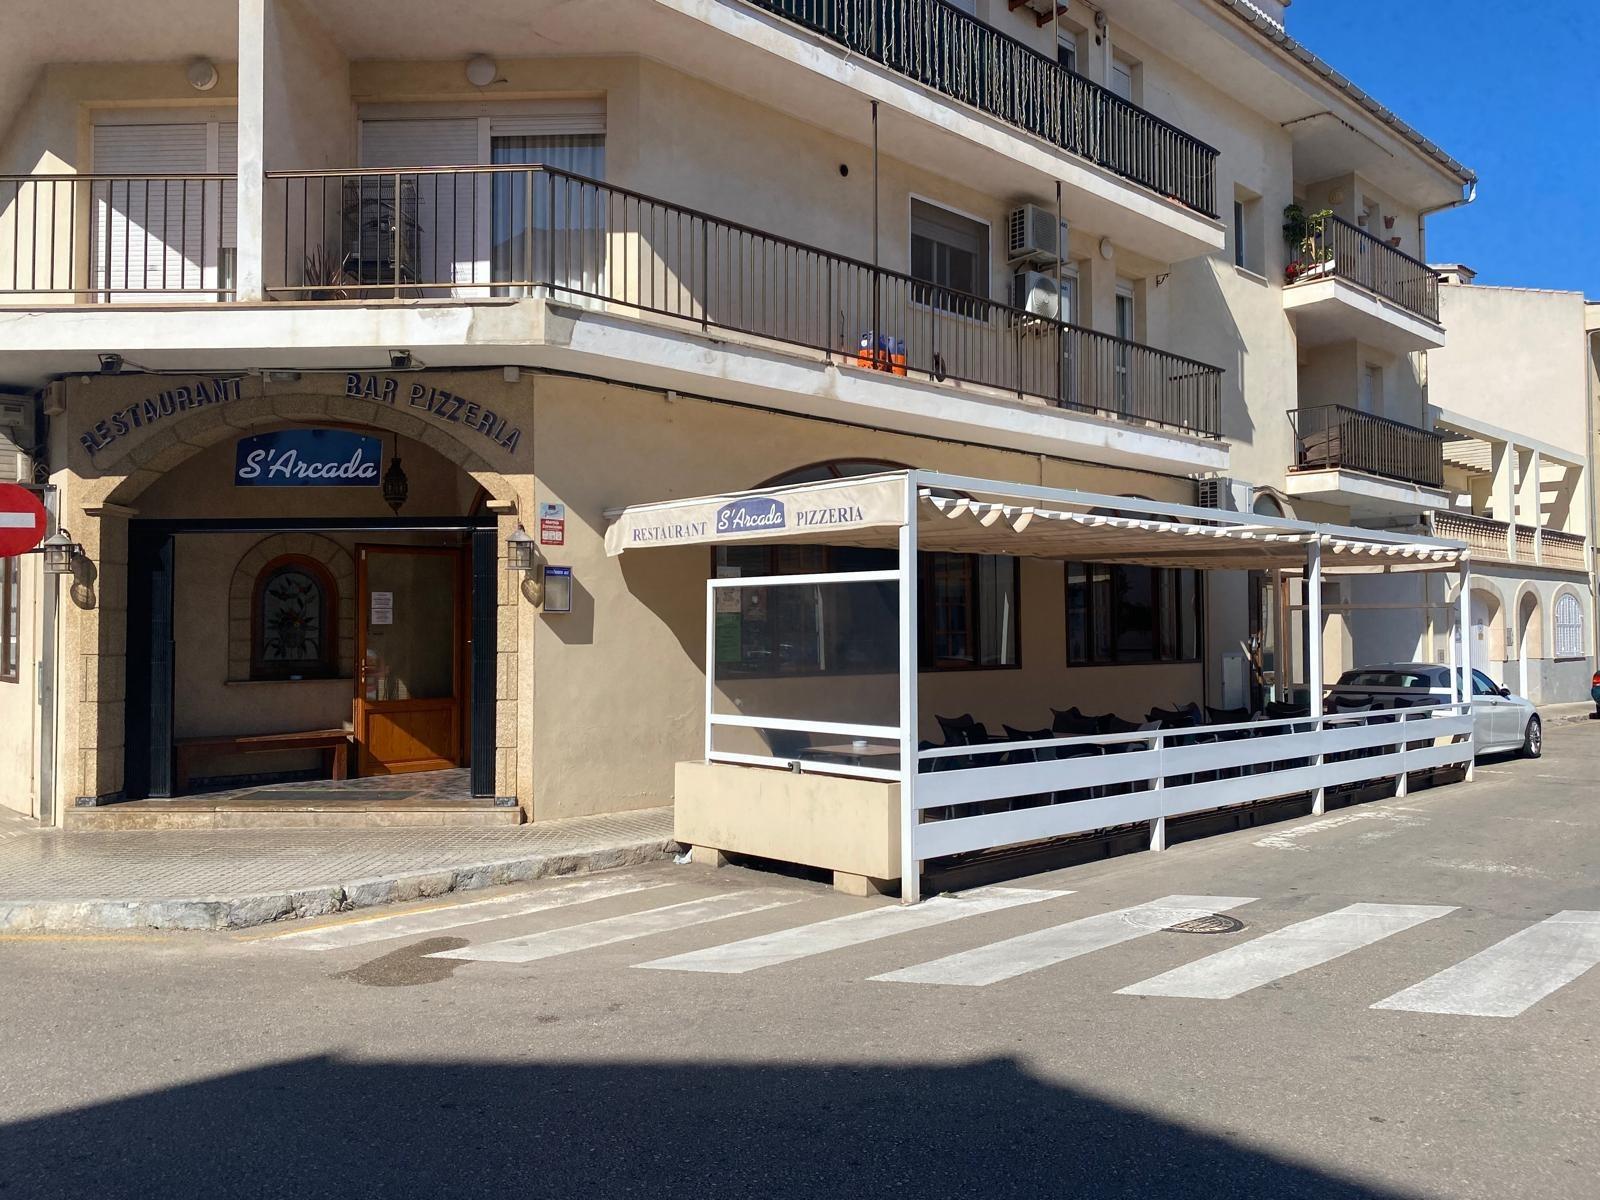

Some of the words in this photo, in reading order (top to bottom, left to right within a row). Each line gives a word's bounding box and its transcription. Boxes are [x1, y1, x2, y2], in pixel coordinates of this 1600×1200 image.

[80, 377, 243, 455] RESTAURANT
[345, 373, 399, 403] BAR
[408, 383, 521, 454] PIZZERIA
[239, 448, 377, 479] S'Arcada
[632, 522, 708, 541] RESTAURANT
[718, 503, 783, 530] S'Arcada
[796, 506, 864, 527] PIZZERIA
